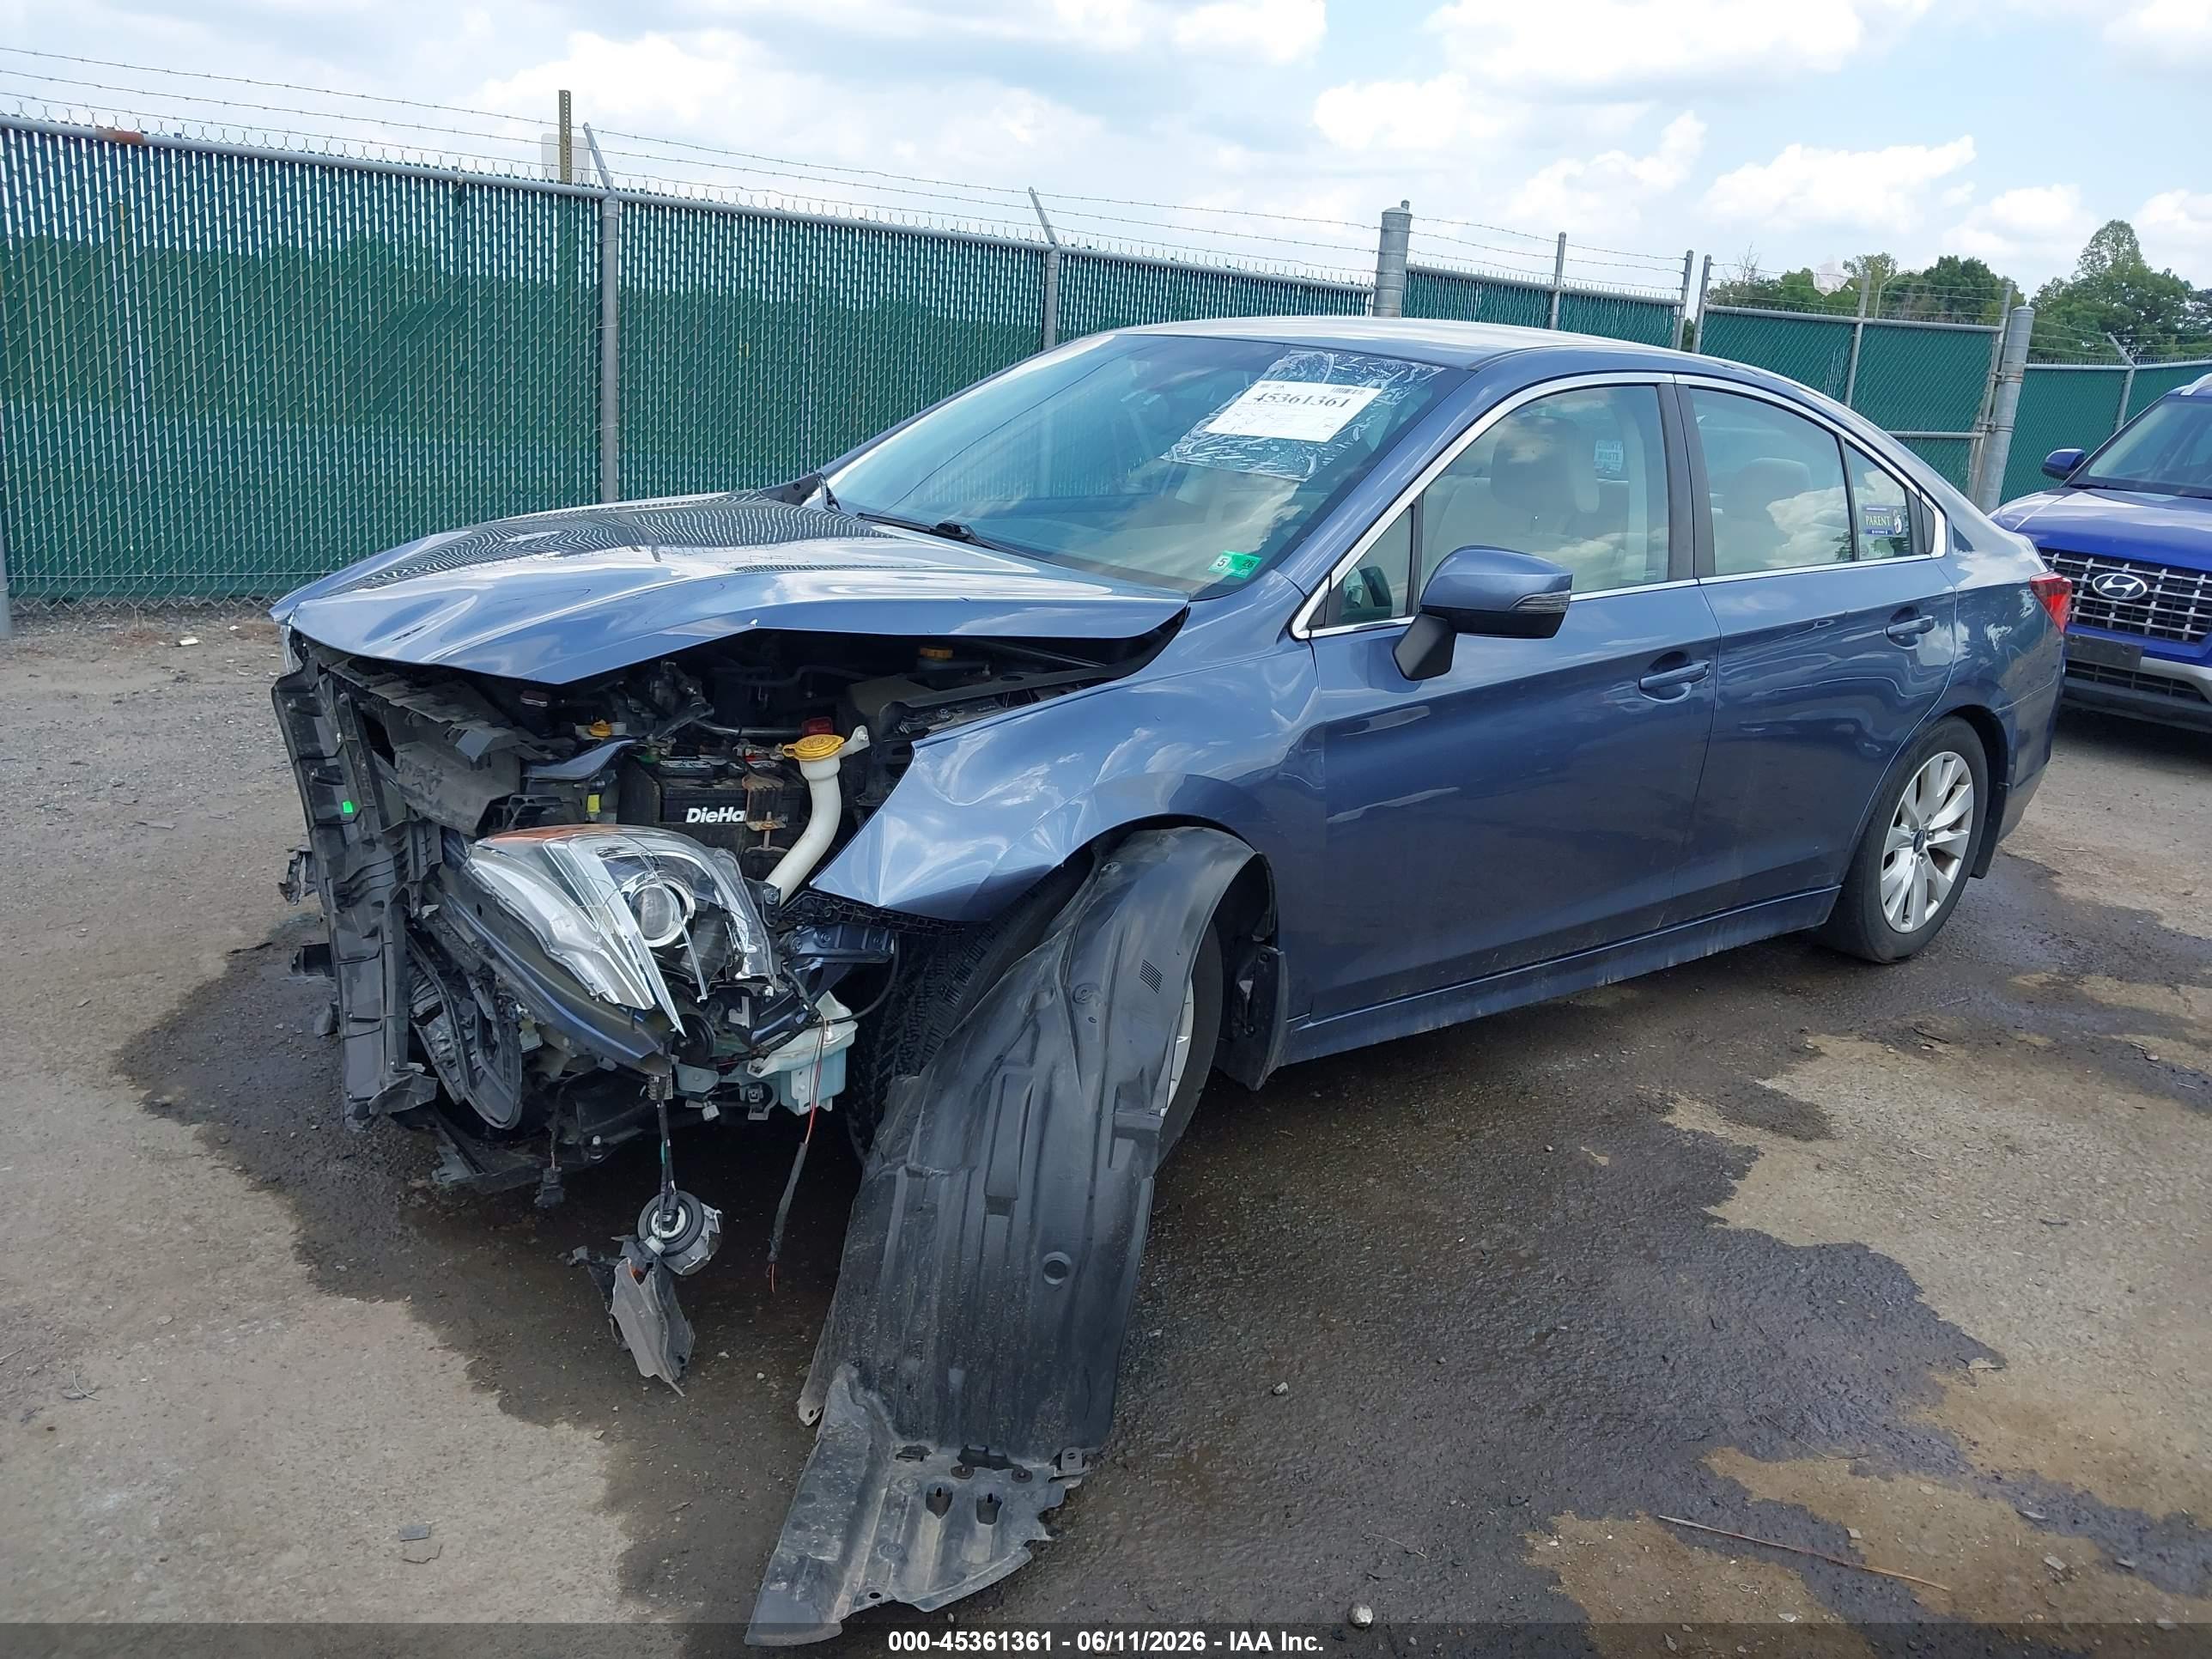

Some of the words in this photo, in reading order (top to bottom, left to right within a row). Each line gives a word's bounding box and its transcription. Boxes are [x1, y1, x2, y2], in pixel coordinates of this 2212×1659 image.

[1253, 392, 1352, 408] 45361361
[1865, 515, 1891, 526] PARENT
[1217, 557, 1228, 567] 5
[1243, 559, 1255, 568] 26
